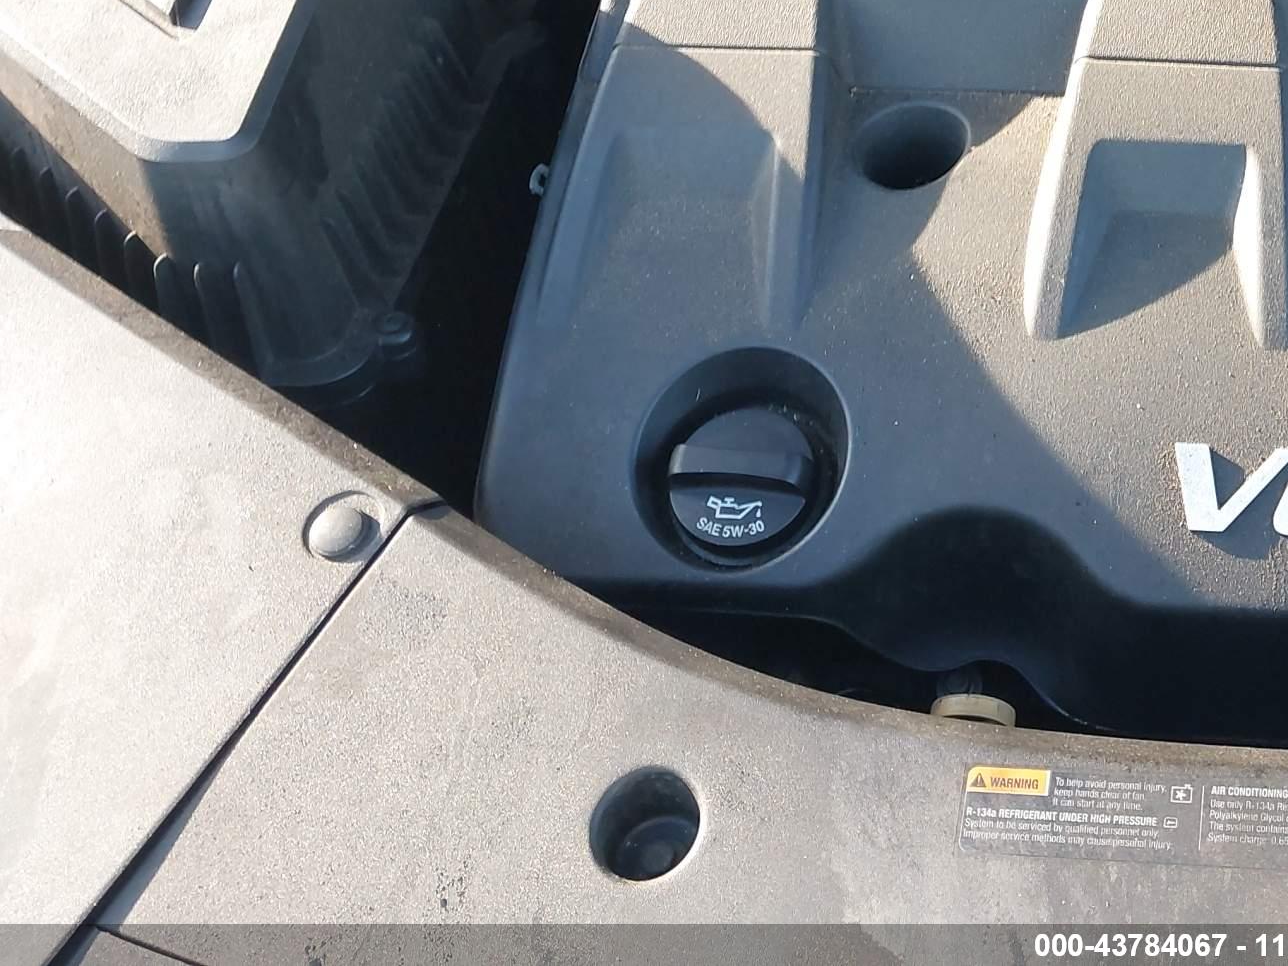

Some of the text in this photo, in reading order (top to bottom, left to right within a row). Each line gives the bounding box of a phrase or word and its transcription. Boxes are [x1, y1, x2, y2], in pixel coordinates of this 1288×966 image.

[696, 517, 765, 538] SAE 5W-30
[990, 776, 1039, 790] WARNING
[1056, 777, 1064, 786] To
[1066, 777, 1083, 788] help
[1085, 780, 1106, 789] avoid
[1108, 781, 1141, 791] personal
[1054, 788, 1073, 798] keep
[1075, 789, 1100, 799] hands
[1101, 790, 1120, 799] clear
[1122, 791, 1131, 800] of
[1211, 785, 1288, 798] AIR CONDITIONING
[1060, 799, 1075, 807] can
[1076, 800, 1095, 808] start
[1096, 801, 1104, 809] at
[1106, 802, 1121, 811] any
[1123, 802, 1143, 811] time.
[1210, 799, 1225, 808] Use
[1226, 801, 1243, 811] only
[965, 806, 1157, 826] R-134a REFRIGERANT UNDER HIGH PRESSURE
[1209, 809, 1258, 822] Polyalkylene
[1260, 812, 1284, 823] Glycol
[964, 818, 994, 830] System
[996, 820, 1004, 829] to
[1006, 820, 1016, 829] be
[1018, 822, 1051, 832] serviced
[1054, 823, 1062, 833] by
[1064, 824, 1099, 835] qualified
[1101, 827, 1140, 838] personnel
[1210, 821, 1224, 831] The
[1256, 824, 1288, 834] contains
[963, 829, 998, 841] Improper
[1000, 832, 1030, 841] service
[1031, 834, 1065, 844] methods
[1068, 836, 1084, 846] may
[1207, 832, 1238, 843] System
